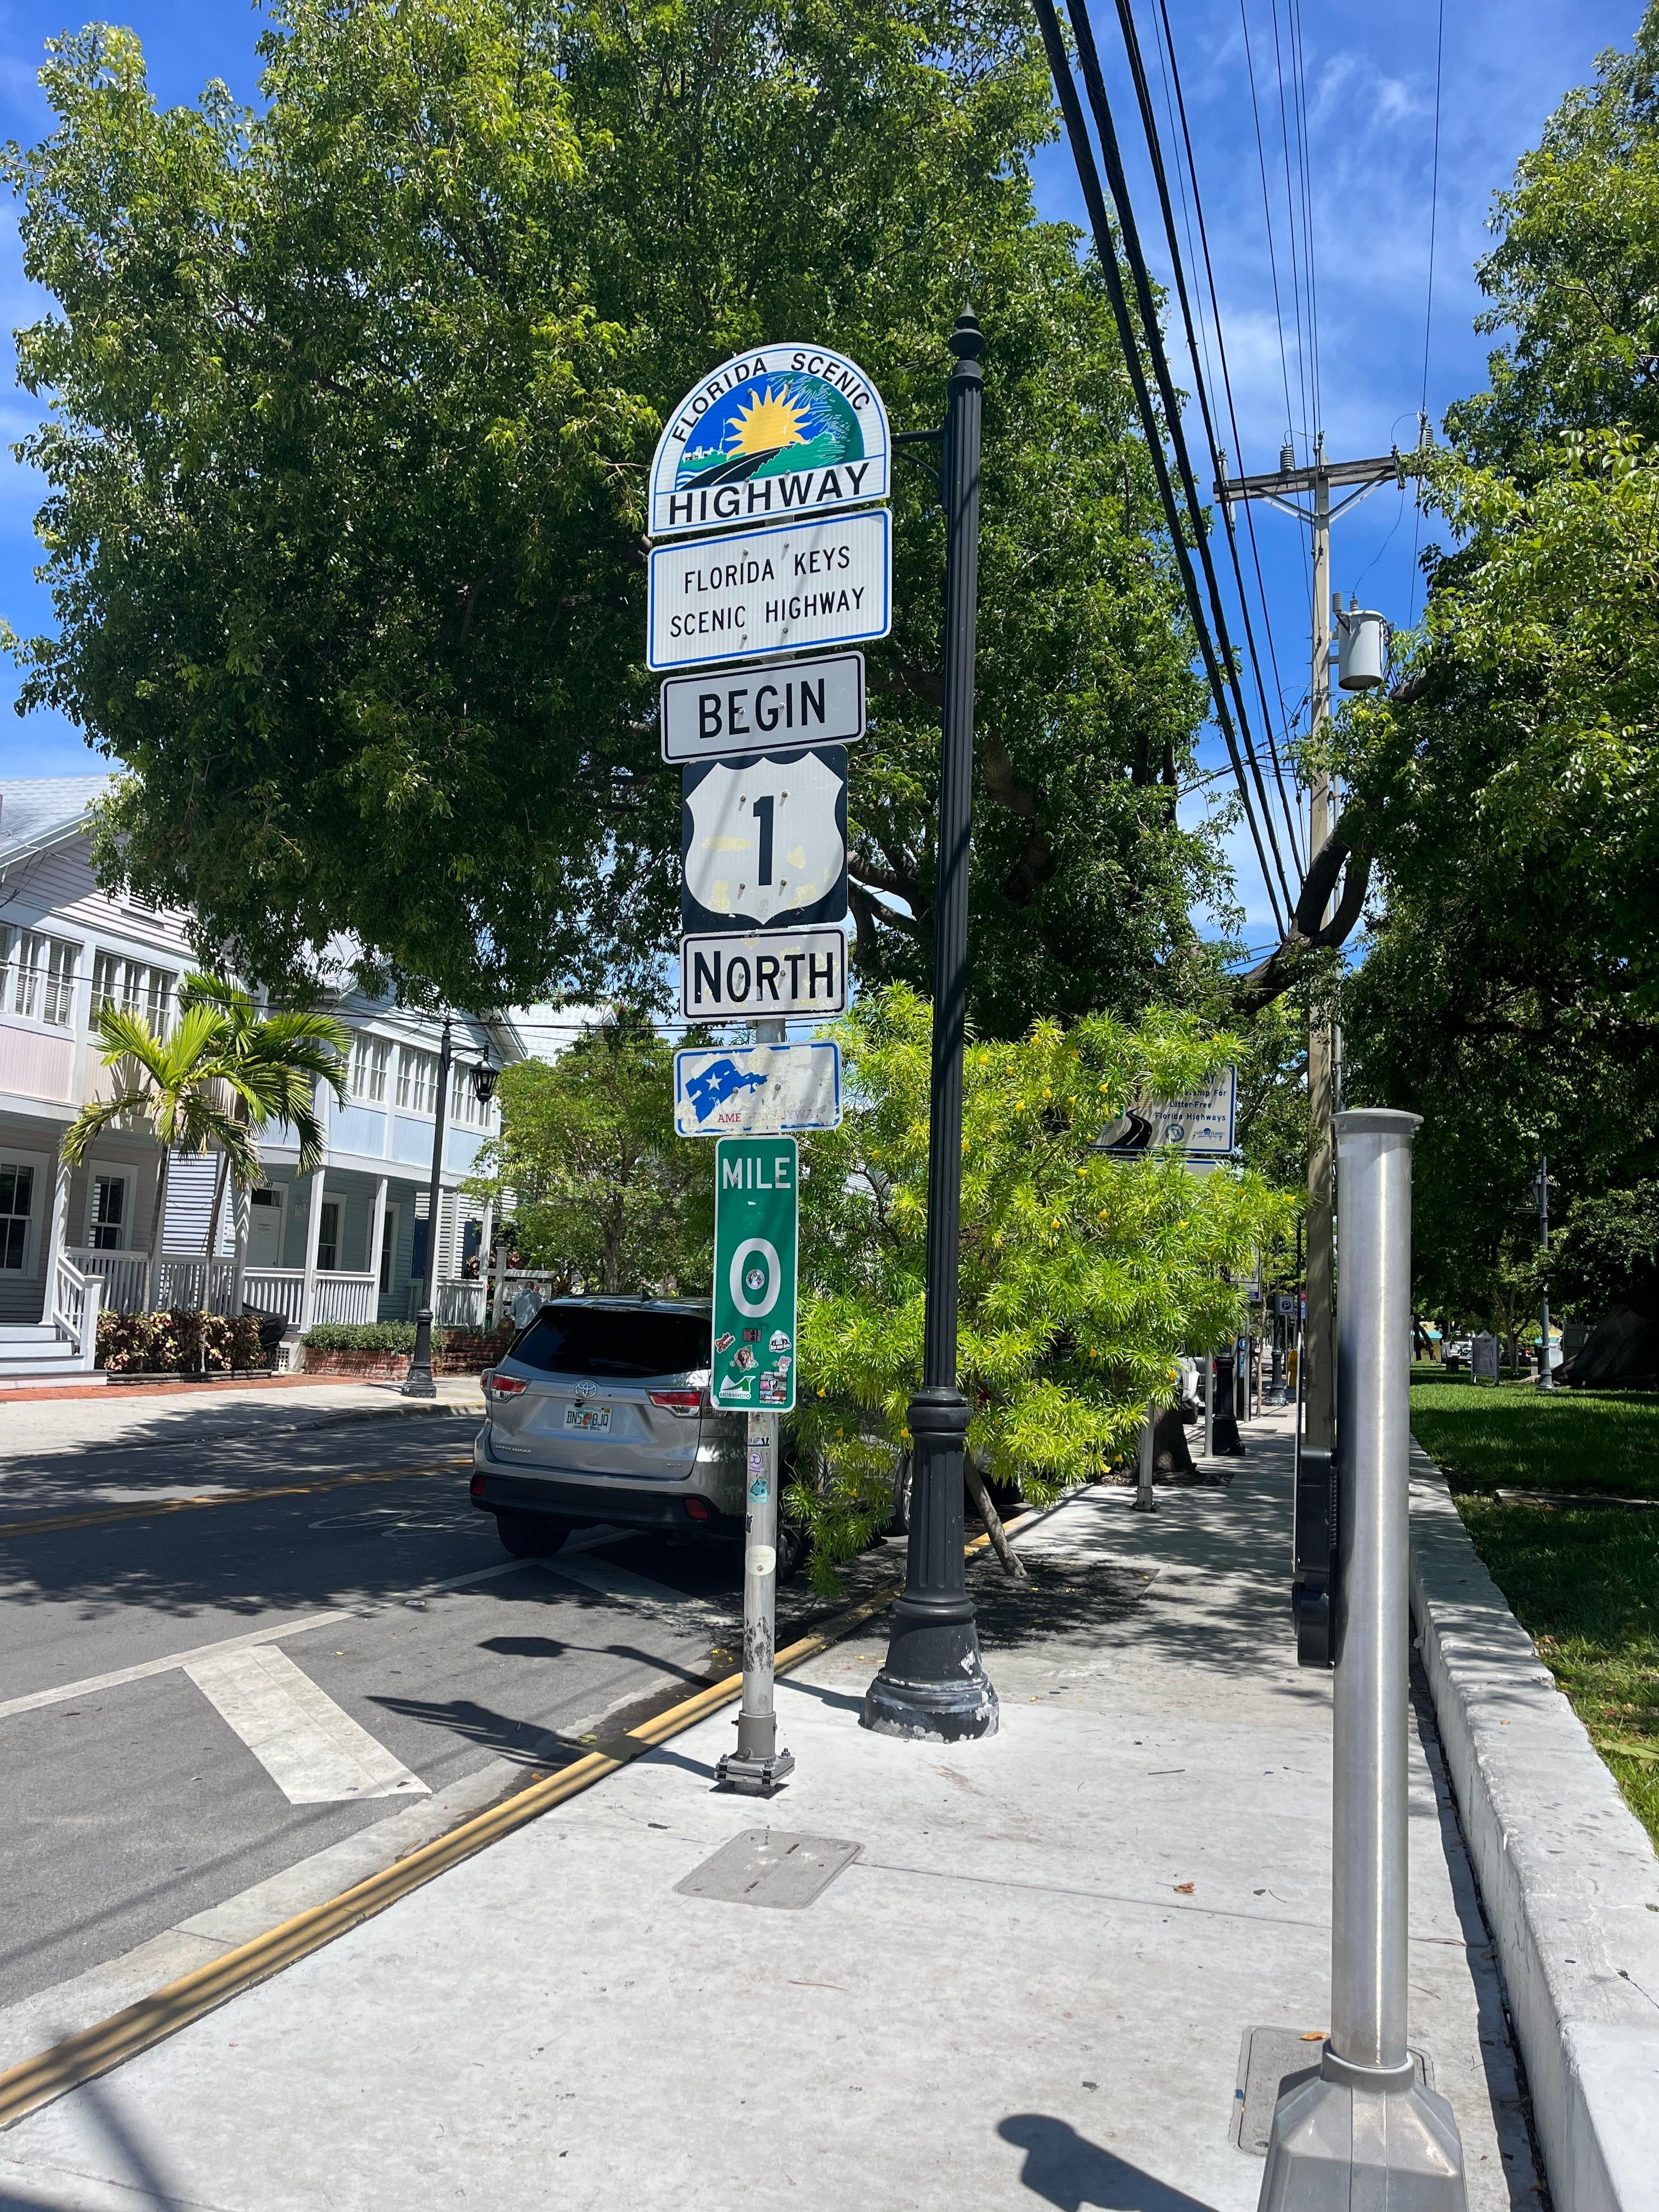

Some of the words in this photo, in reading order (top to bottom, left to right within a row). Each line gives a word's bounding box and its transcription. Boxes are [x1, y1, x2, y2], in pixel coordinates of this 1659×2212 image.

[672, 357, 768, 443] FLORIDA
[791, 353, 871, 411] SCENIC
[669, 462, 870, 525] HIGHWAY
[685, 558, 775, 594] FLORIDA
[794, 545, 850, 576] KEYS
[670, 606, 746, 637] SCENIC
[765, 586, 865, 623] HIGHWAY
[698, 678, 826, 739] BEGIN
[752, 795, 775, 886] 1
[694, 951, 834, 1005] NORTH
[1187, 1113, 1226, 1122] Highways
[723, 1157, 791, 1189] MILE
[730, 1238, 781, 1318] 0
